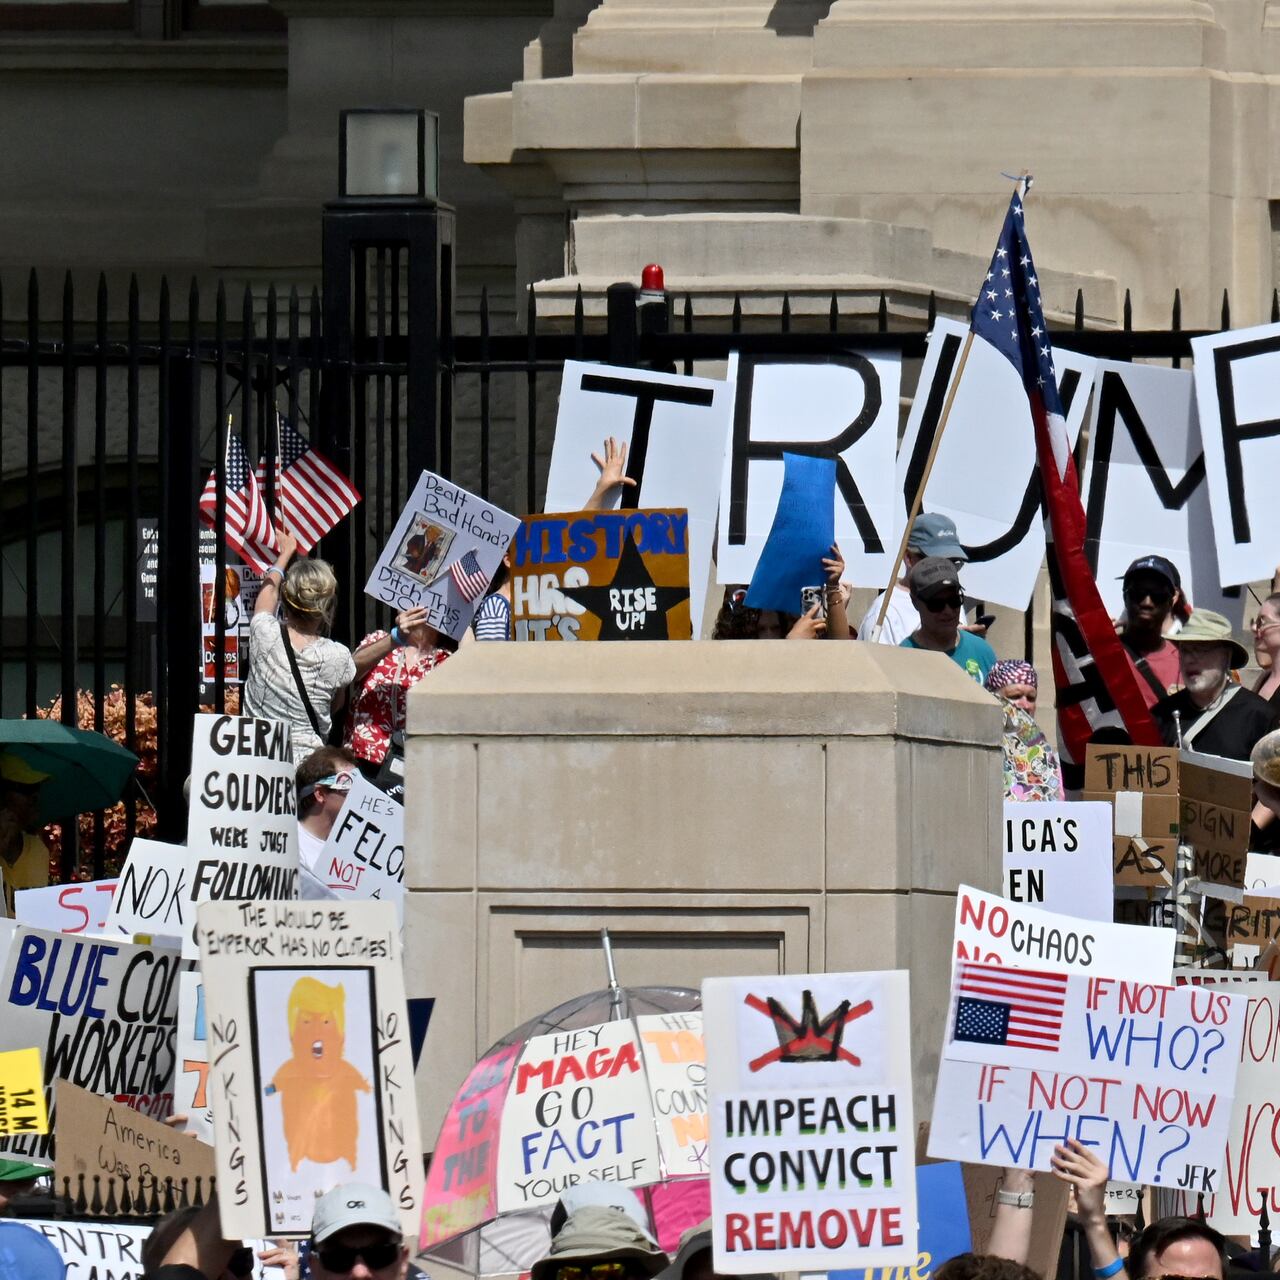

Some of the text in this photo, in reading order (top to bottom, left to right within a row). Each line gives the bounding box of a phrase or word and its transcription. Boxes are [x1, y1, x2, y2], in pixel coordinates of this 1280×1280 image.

[425, 475, 468, 505] Dealt
[423, 493, 510, 549] Bad Hand?
[515, 512, 688, 566] HISTORY
[378, 566, 461, 622] Ditch This
[609, 587, 657, 612] RISE
[616, 612, 645, 630] UP!
[1097, 752, 1170, 789] THIS
[200, 771, 296, 816] SOLDIERS
[210, 827, 288, 854] WERE JUST
[191, 860, 299, 901] FOLLOWING
[238, 903, 350, 930] THE WOULD BE
[960, 894, 1096, 967] NO CHAOS
[280, 931, 394, 960] HAS NO CLOTHES!
[9, 934, 118, 1020] BLUE
[1087, 978, 1231, 1025] IF NOT US
[552, 1027, 603, 1053] HEY
[1087, 1013, 1225, 1073] WHO?
[516, 1043, 641, 1094] MAGA
[535, 1087, 593, 1128] GO
[726, 1095, 897, 1137] IMPEACH
[978, 1065, 1217, 1128] IF NOT NOW
[102, 1107, 181, 1166] America
[521, 1112, 635, 1174] FACT
[724, 1145, 898, 1192] CONVICT
[1177, 1165, 1216, 1193] JFK
[725, 1207, 902, 1251] REMOVE
